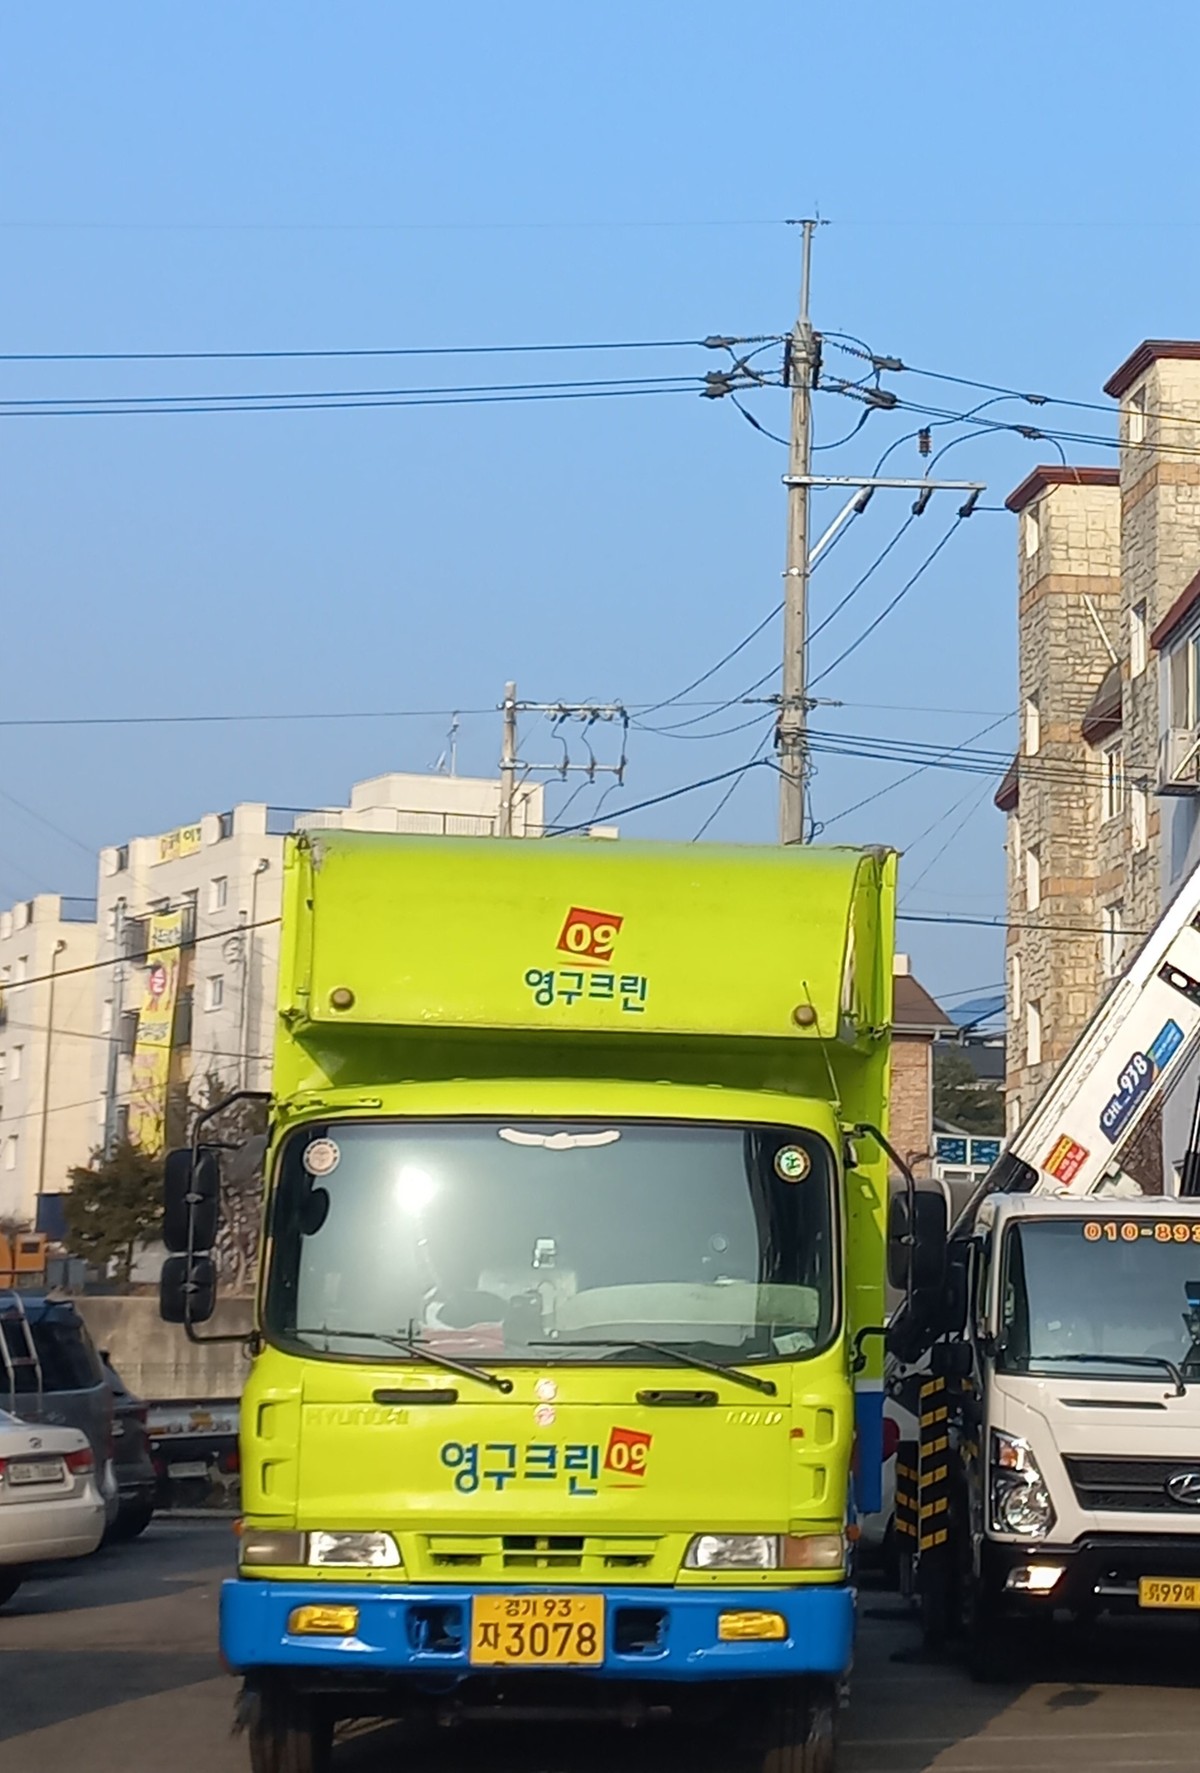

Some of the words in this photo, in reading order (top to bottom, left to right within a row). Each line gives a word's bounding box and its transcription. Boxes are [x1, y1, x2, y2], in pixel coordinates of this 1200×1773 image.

[565, 922, 618, 955] 09
[524, 968, 648, 1013] 영구크린
[440, 1441, 599, 1496] 영구크린
[608, 1439, 649, 1473] 09
[504, 1599, 538, 1617] 경기
[543, 1598, 572, 1617] 93
[477, 1622, 597, 1657] 자3078
